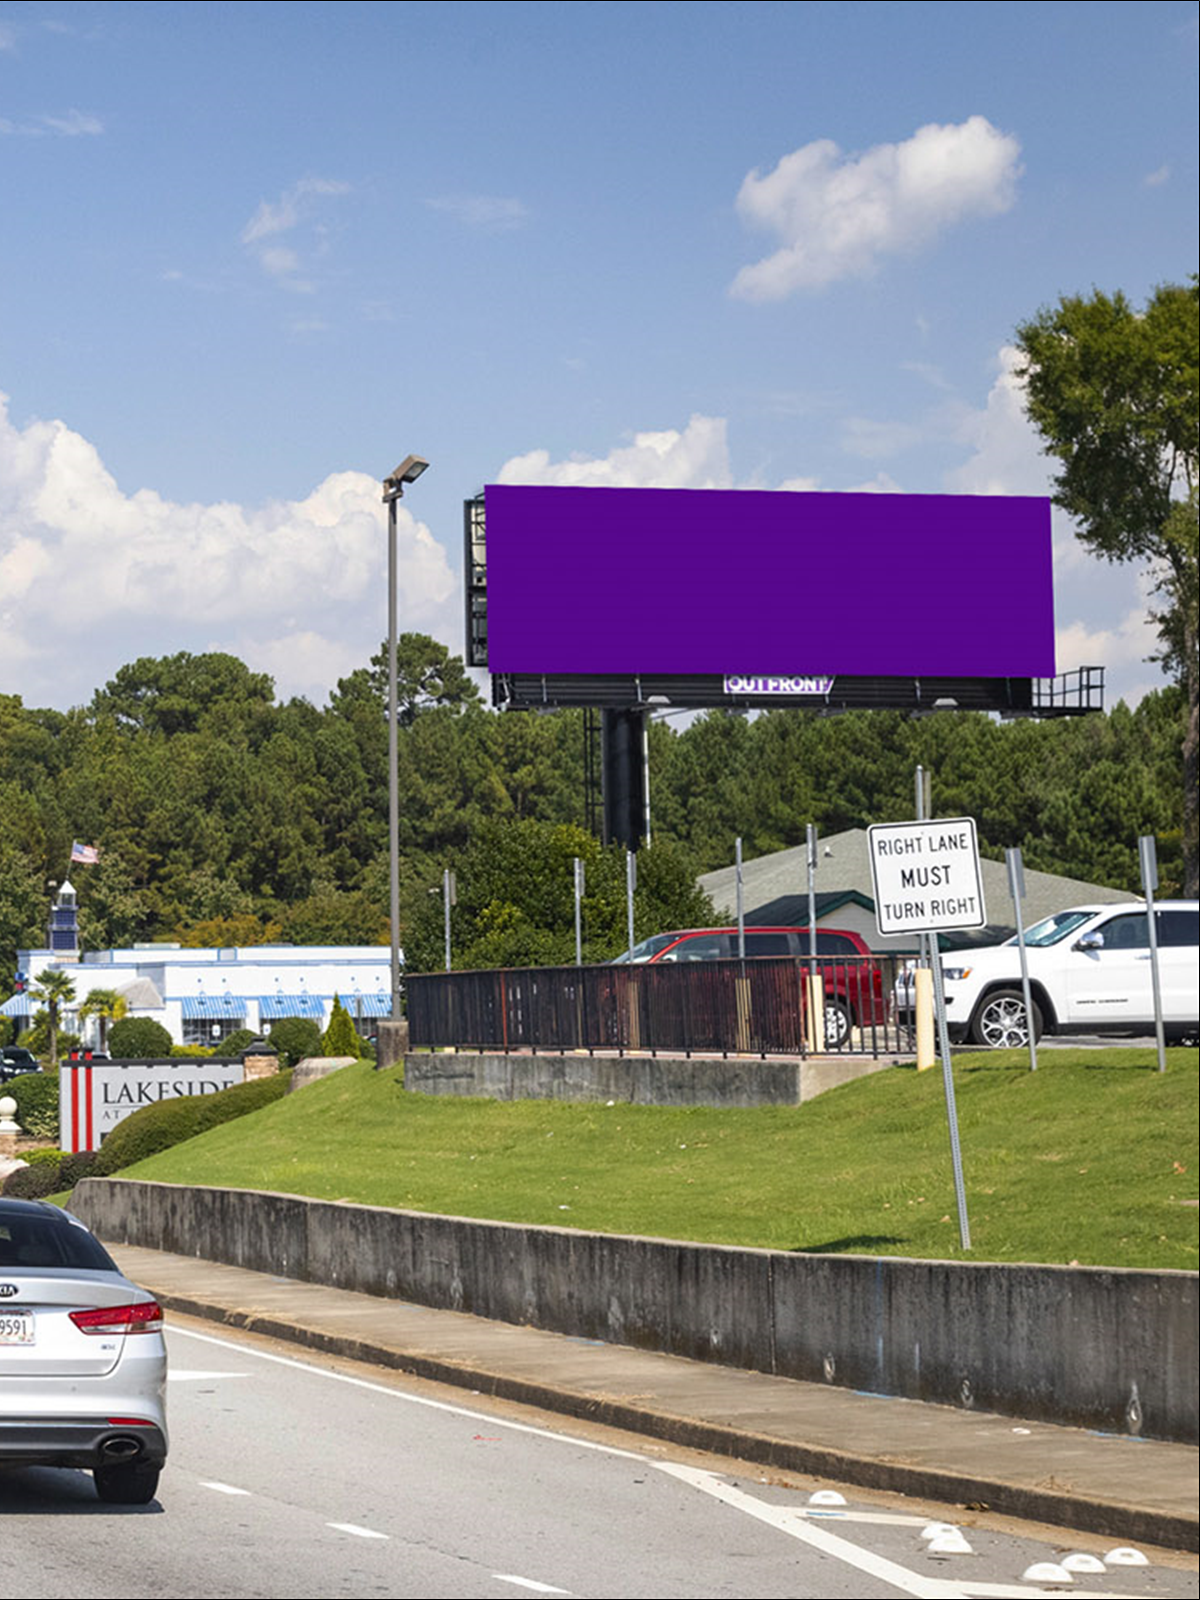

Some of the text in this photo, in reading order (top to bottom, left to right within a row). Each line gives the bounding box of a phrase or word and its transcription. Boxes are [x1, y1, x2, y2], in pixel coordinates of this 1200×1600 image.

[728, 677, 825, 692] OUTFRONT
[877, 833, 969, 856] RIGHT LANE
[901, 865, 951, 889] MUST
[883, 897, 975, 920] TURN RIGHT
[103, 1110, 120, 1119] AT
